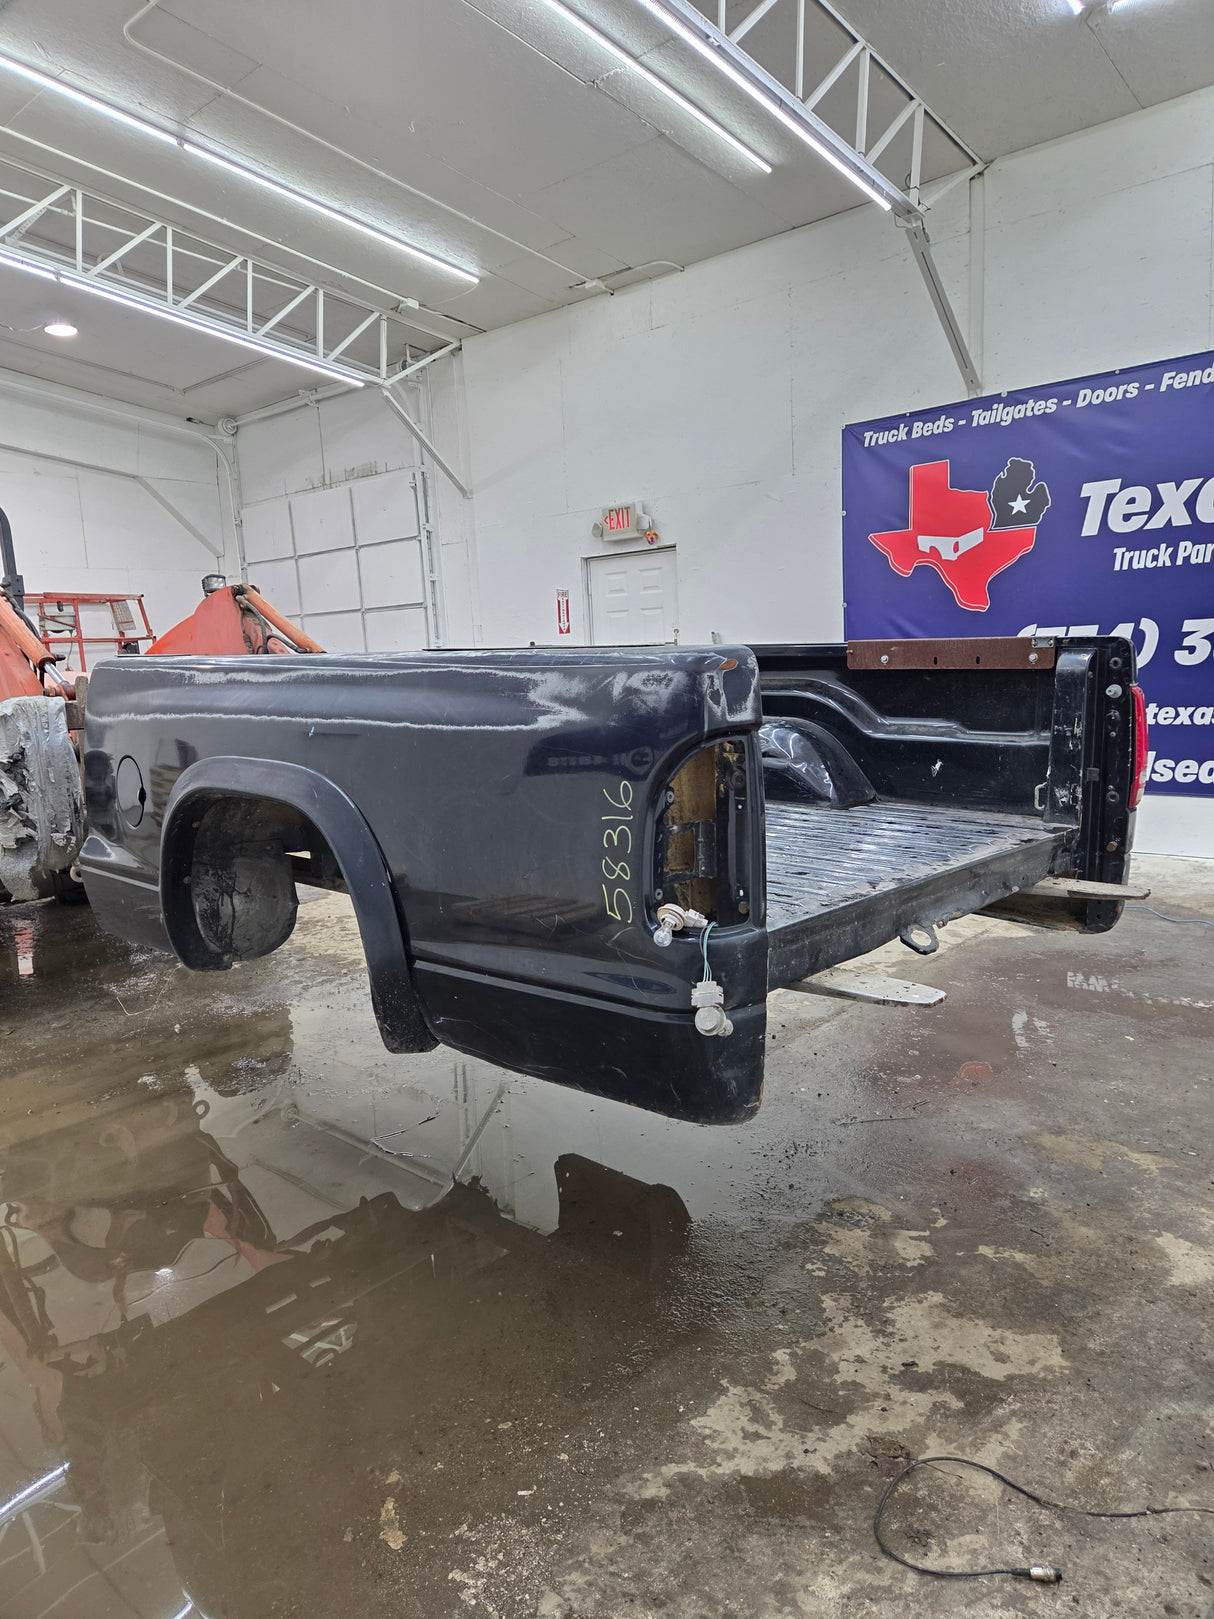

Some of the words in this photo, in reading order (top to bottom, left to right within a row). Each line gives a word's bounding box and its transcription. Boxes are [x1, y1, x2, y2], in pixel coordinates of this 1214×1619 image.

[863, 423, 910, 448] Truck
[911, 415, 955, 439] Beds
[971, 398, 1058, 427] Tailgates
[1076, 382, 1140, 408] Doors
[1159, 362, 1214, 392] Fend
[608, 506, 631, 531] EXIT
[1113, 543, 1174, 571] Truck
[1176, 540, 1214, 566] Par
[1174, 618, 1214, 666] 3
[1145, 703, 1214, 726] texa
[602, 780, 634, 924] 58316
